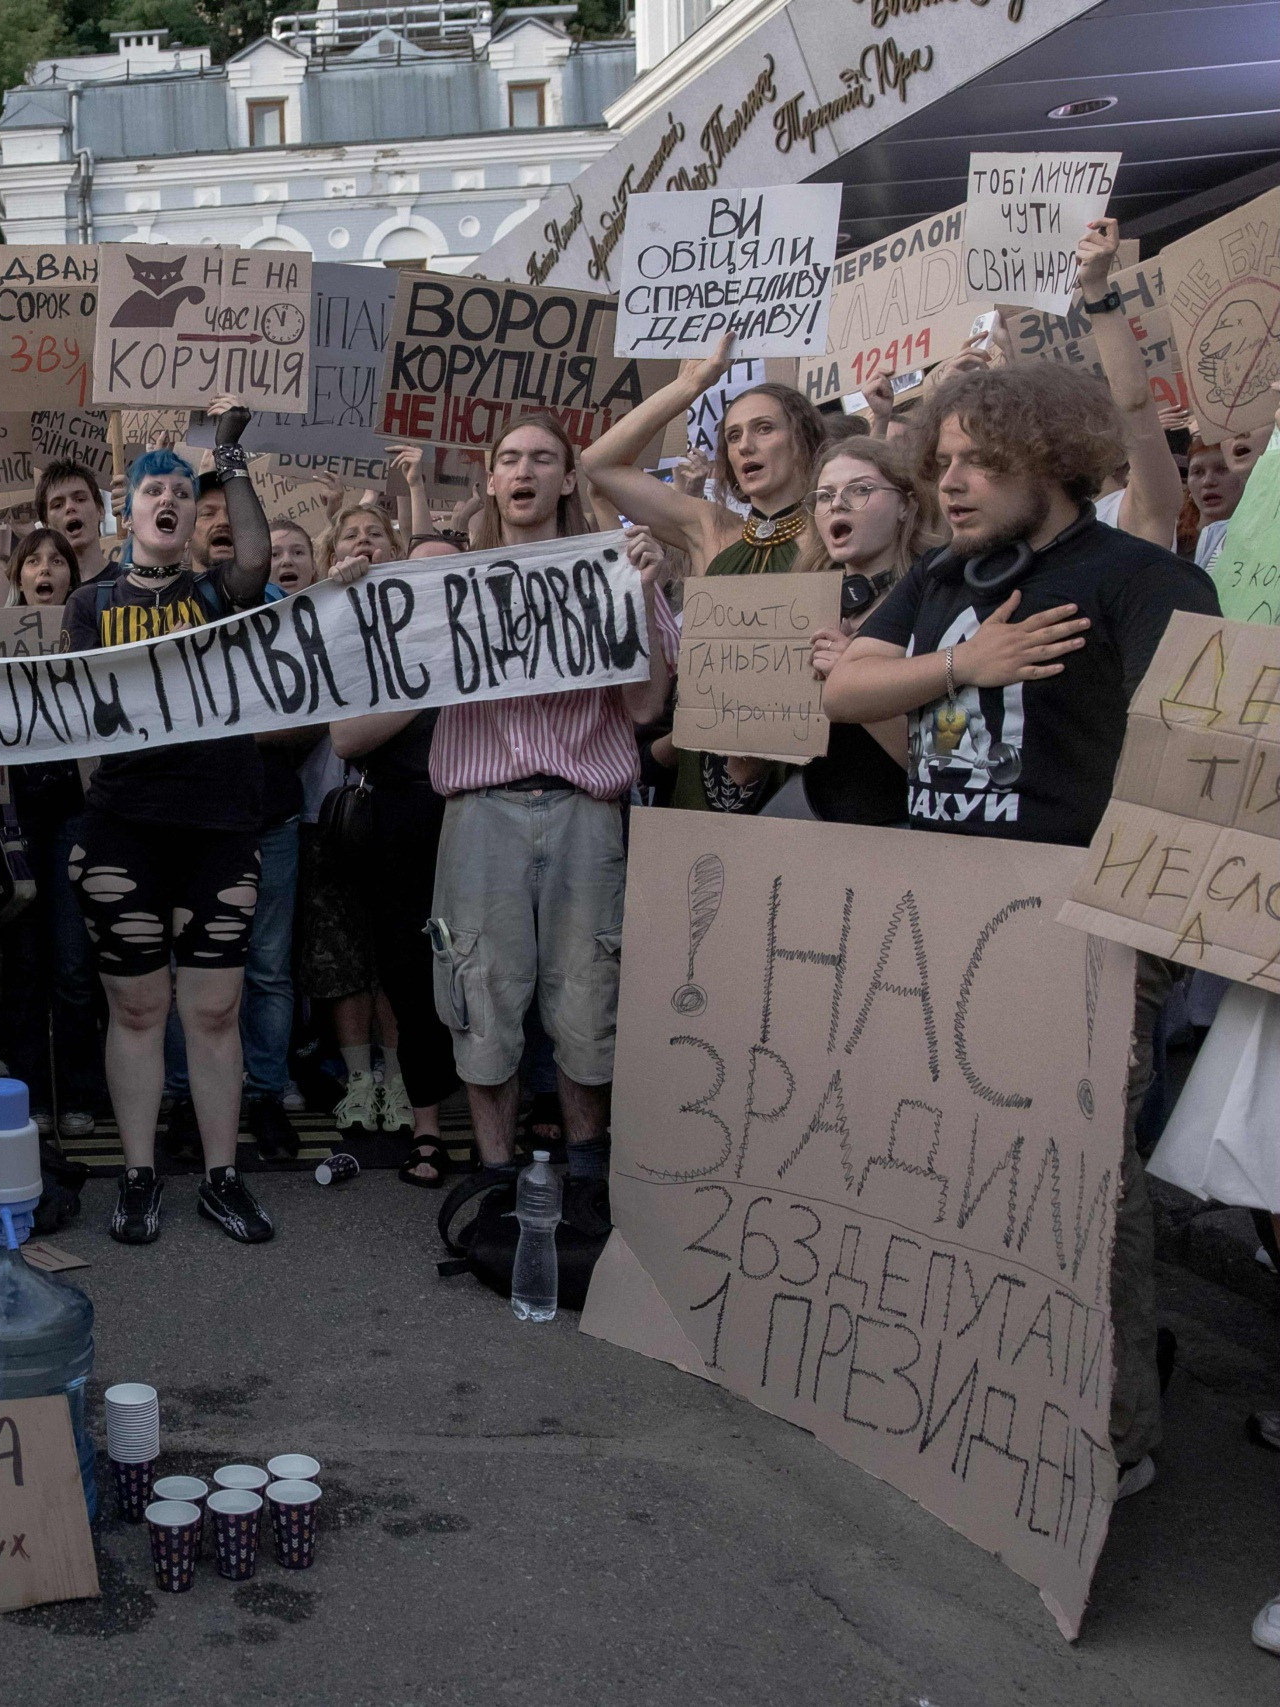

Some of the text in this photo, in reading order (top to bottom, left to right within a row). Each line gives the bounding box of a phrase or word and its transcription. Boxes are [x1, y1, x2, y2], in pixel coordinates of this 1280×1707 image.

[860, 37, 934, 102] Юра
[1031, 161, 1113, 196] ЛИЧИТЬ
[708, 194, 764, 239] ВИ
[1001, 203, 1062, 234] ЧУТИ
[832, 208, 967, 287] ПЕРБОЛОН
[203, 257, 298, 293] НЕ НА
[625, 263, 831, 315] СПРАВЕДЛИВУ
[1170, 258, 1223, 328] НЕ
[405, 281, 620, 352] ВОРОГ
[630, 299, 822, 350] ДЕРЖАВУ!
[109, 338, 304, 398] КОРУПЦІЯ
[599, 358, 644, 408] А
[806, 361, 841, 400] НА
[383, 392, 437, 438] НЕ
[349, 578, 431, 708] НЕ
[635, 1034, 1111, 1305] ЗРАДИЛИ
[683, 1185, 821, 1285] 263
